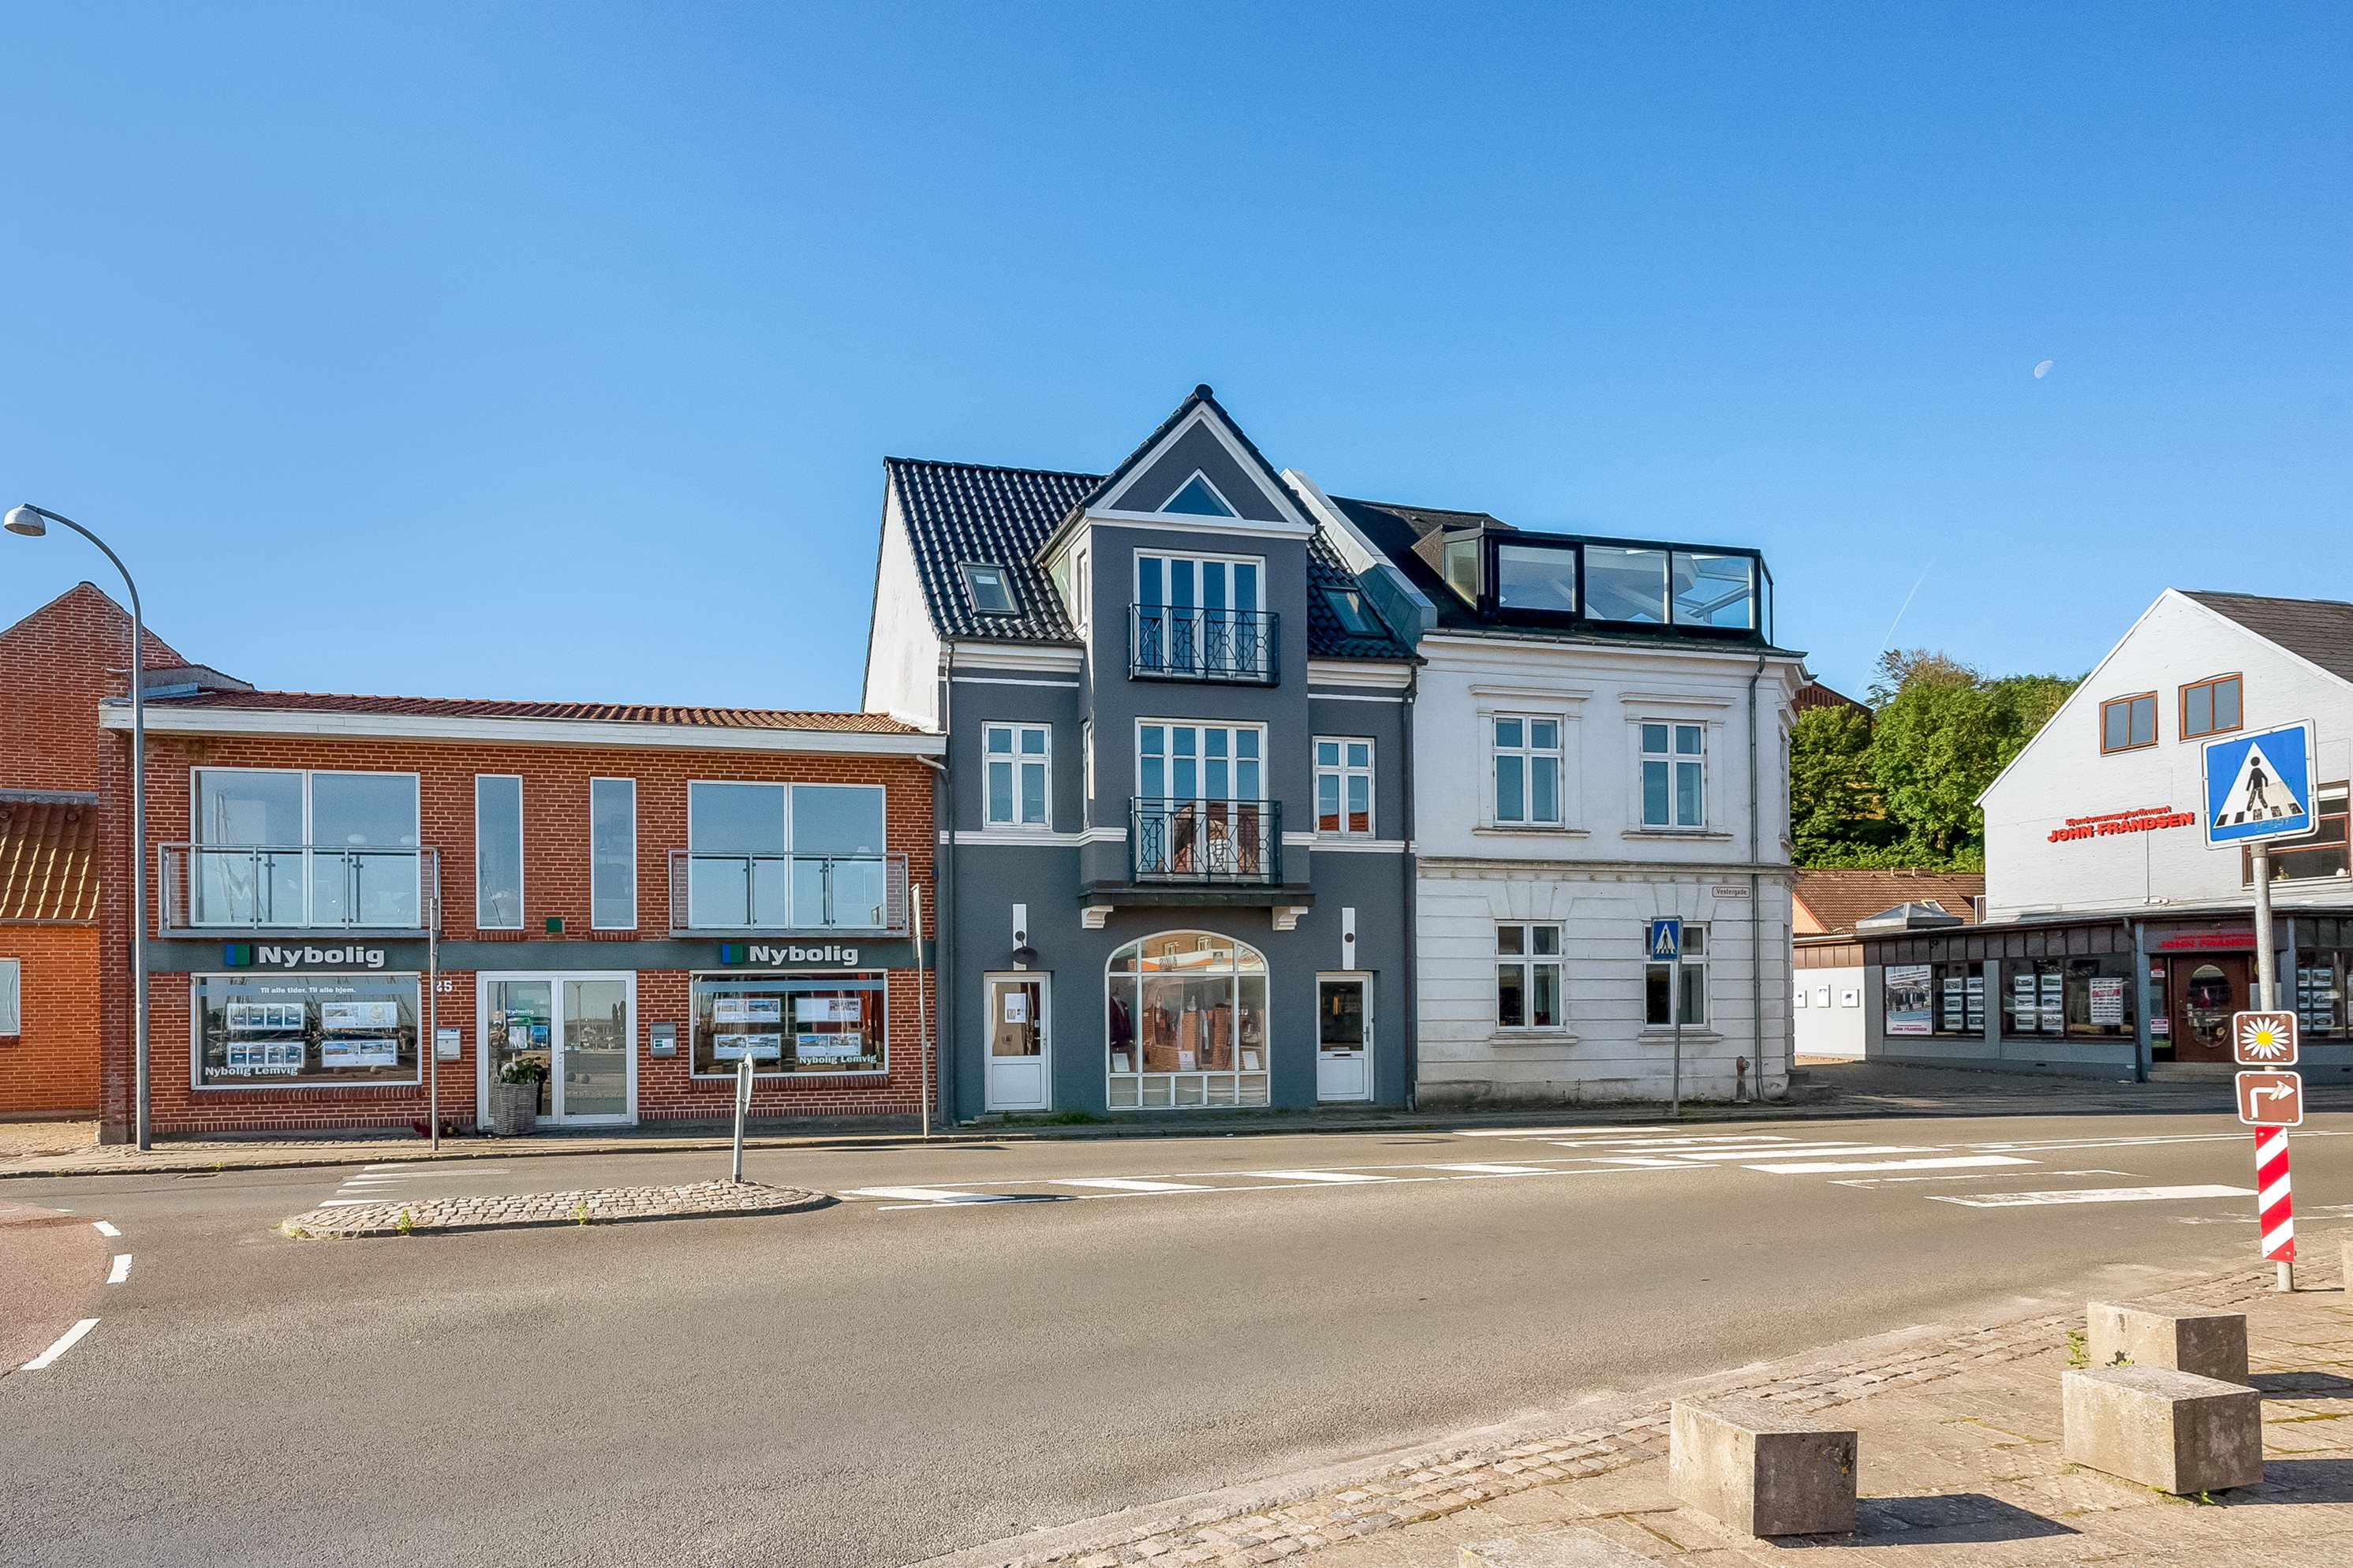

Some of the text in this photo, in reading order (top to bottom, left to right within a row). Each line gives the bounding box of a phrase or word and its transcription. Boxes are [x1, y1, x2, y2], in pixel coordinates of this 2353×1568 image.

[2048, 812, 2195, 842] JOHN FRANDSEN
[1716, 888, 1747, 897] Vestergade
[259, 946, 385, 969] Nybolig
[749, 946, 858, 966] Nybolig
[799, 1054, 877, 1066] Nybolig Lemvig
[205, 1066, 298, 1077] Nybolig Lemvig
